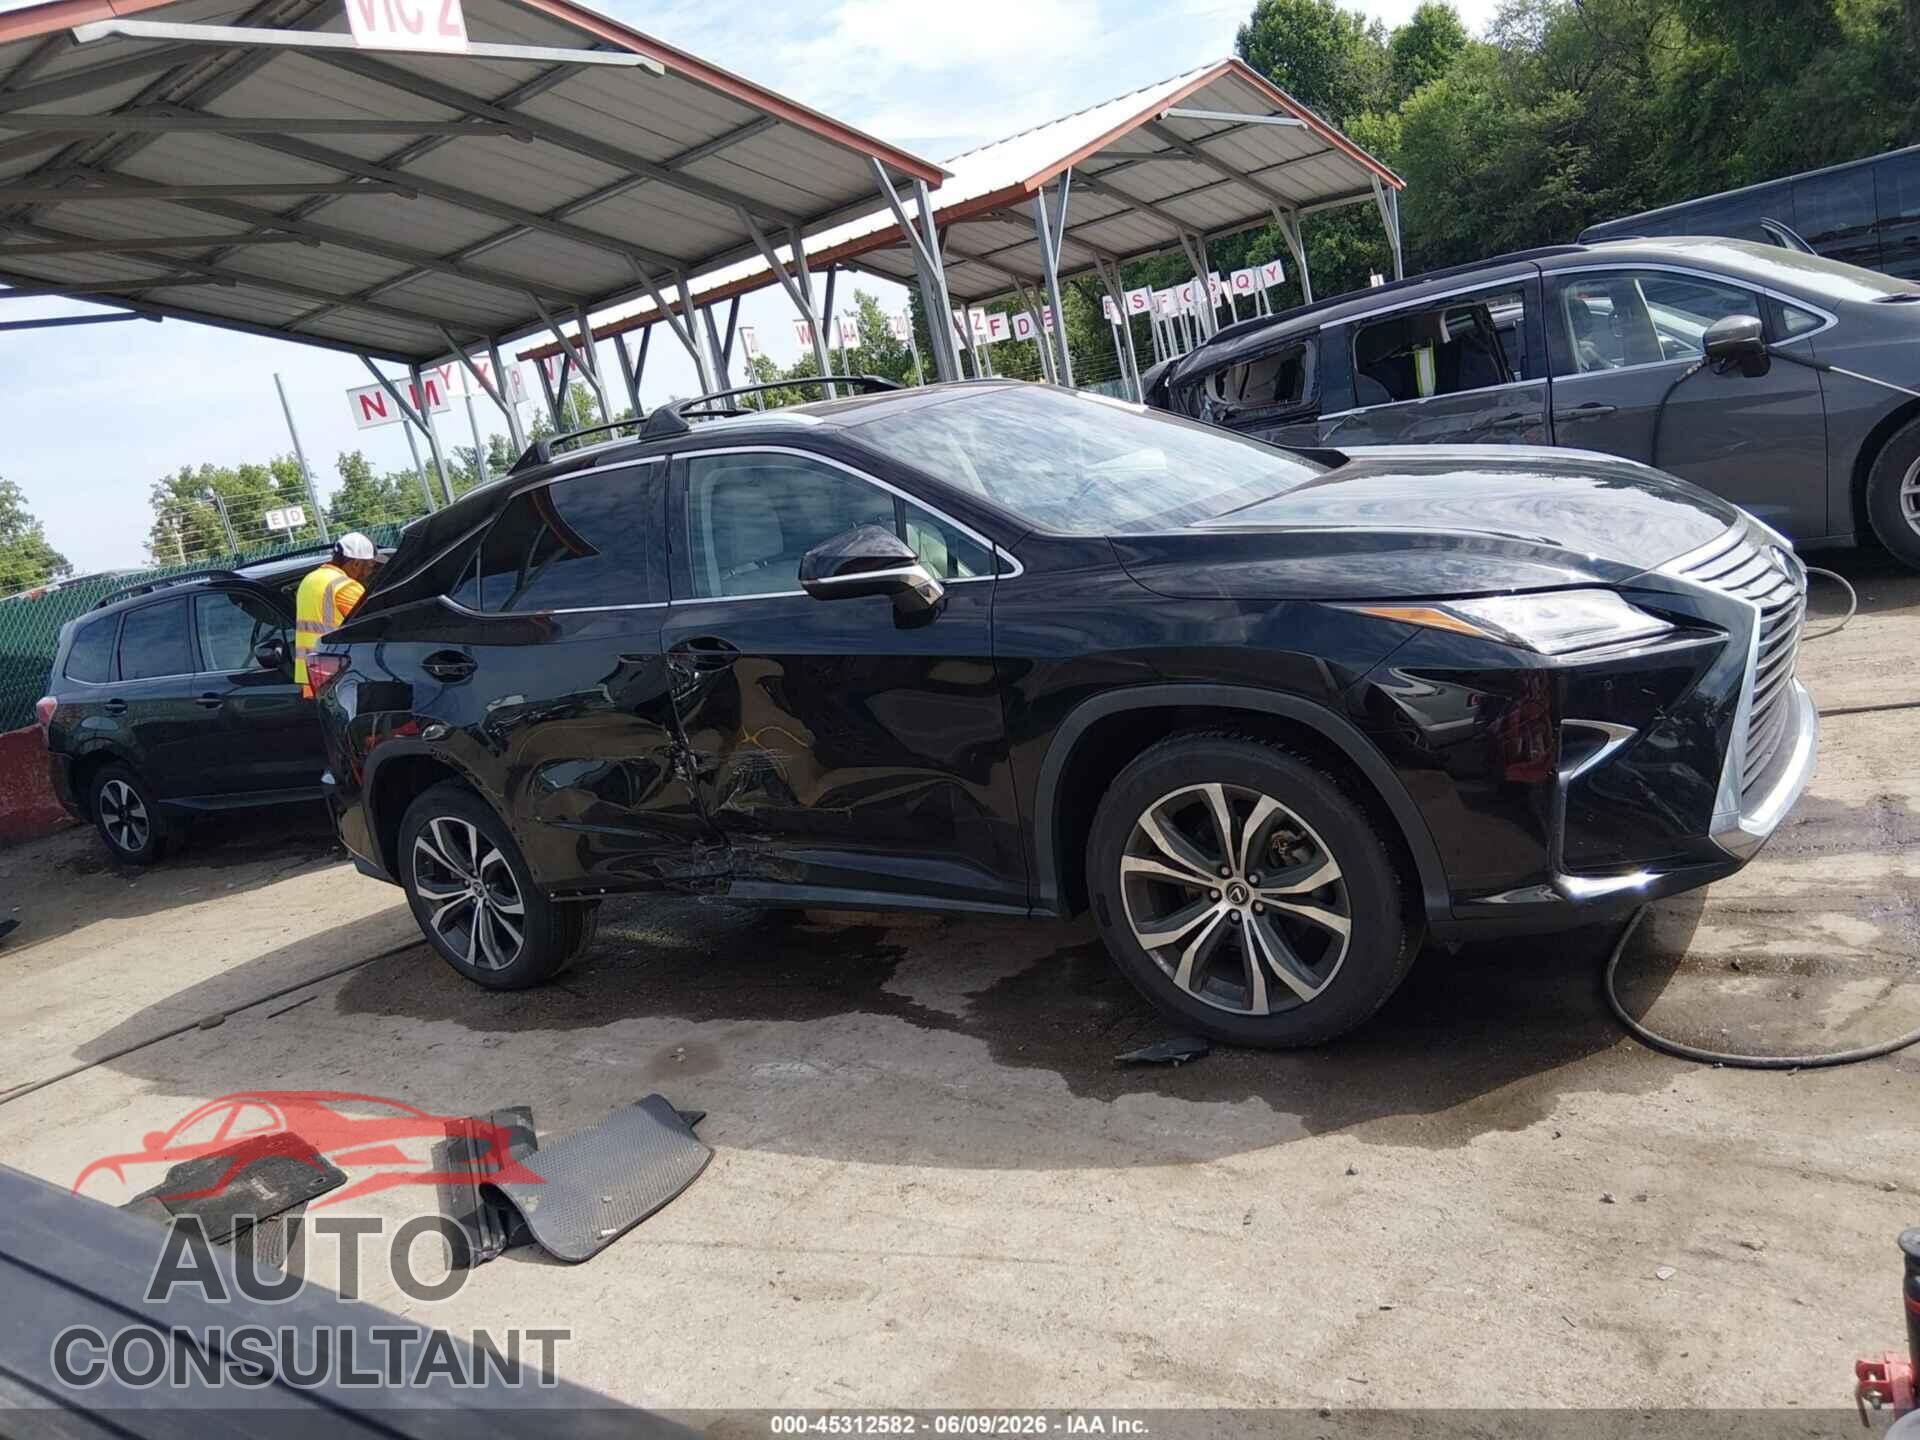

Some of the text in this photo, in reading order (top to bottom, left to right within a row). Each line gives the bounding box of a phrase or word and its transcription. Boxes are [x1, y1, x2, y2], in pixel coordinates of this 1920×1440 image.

[1266, 265, 1277, 280] Y
[1236, 274, 1249, 289] Q
[1132, 294, 1145, 309] S
[989, 318, 1001, 337] F
[1018, 318, 1030, 335] D
[437, 363, 452, 390] Y
[408, 379, 441, 410] M
[358, 390, 388, 421] N
[272, 513, 282, 525] E
